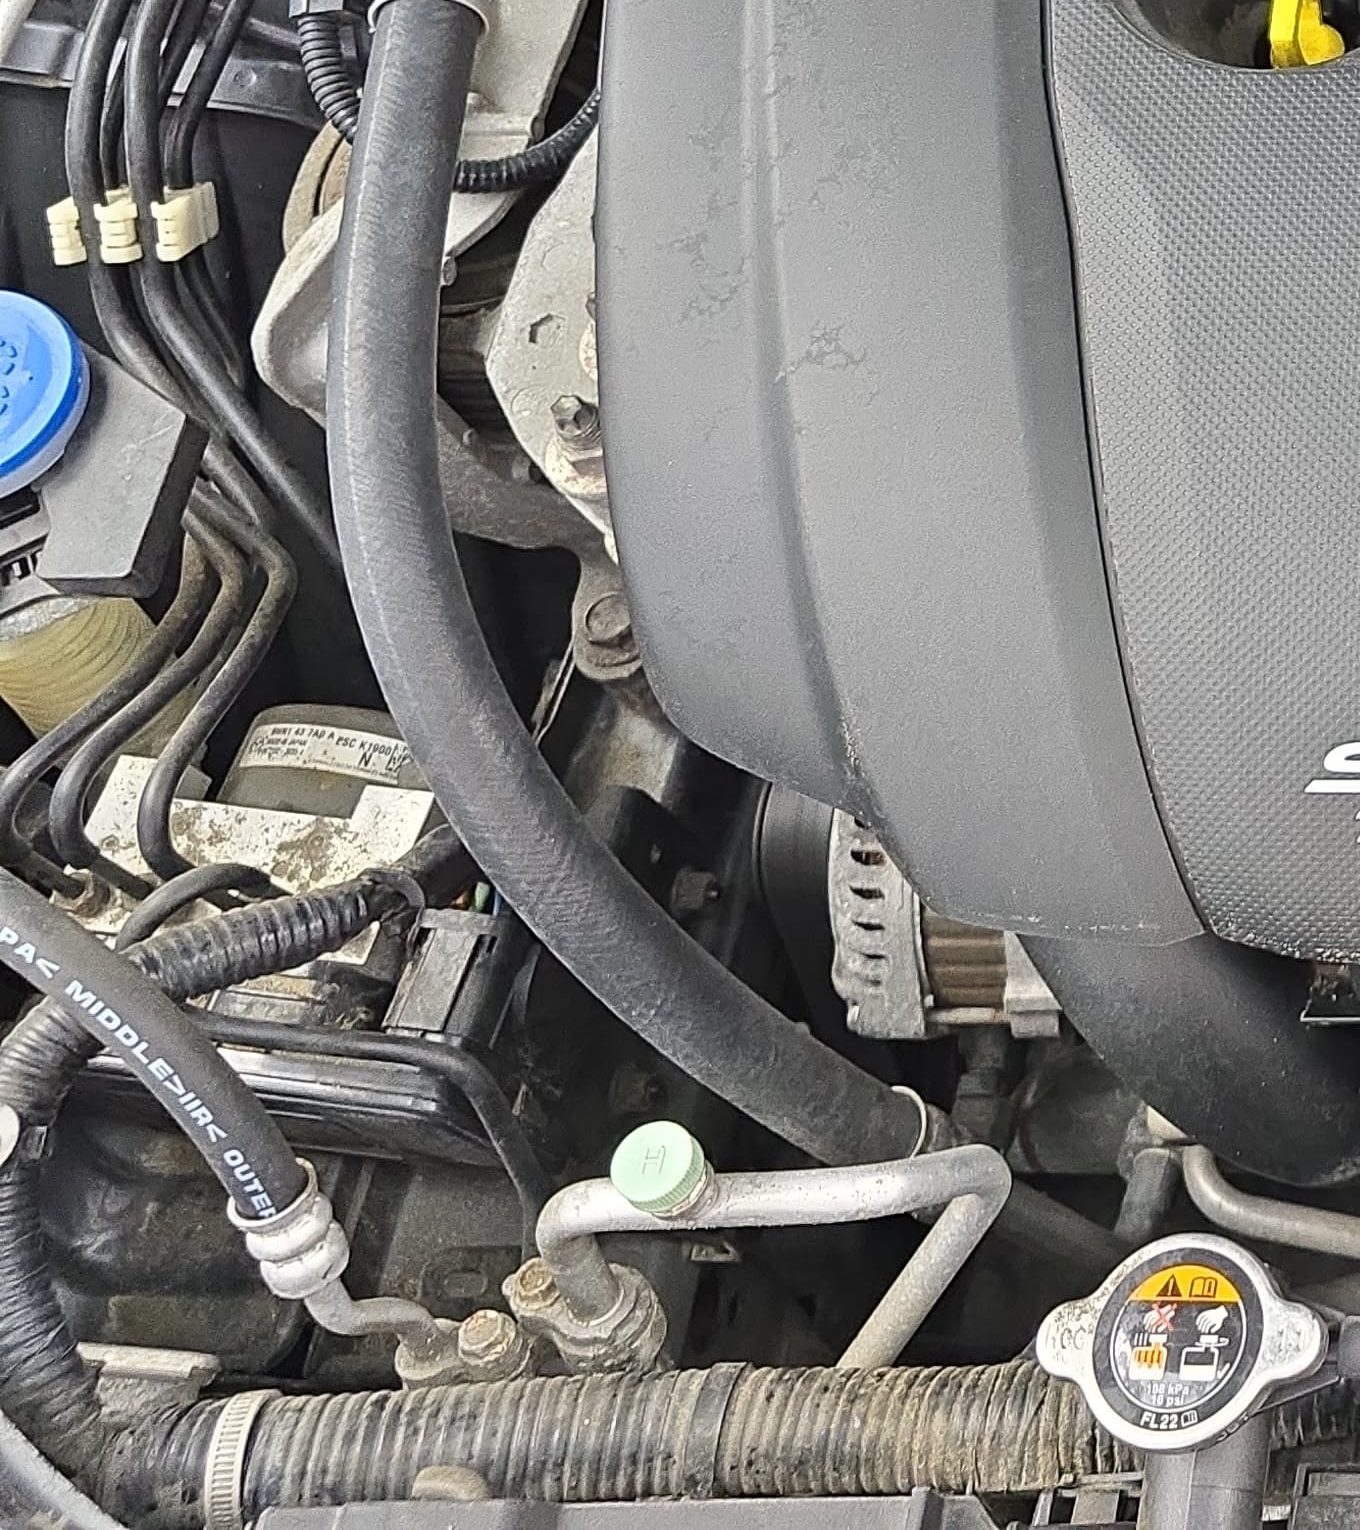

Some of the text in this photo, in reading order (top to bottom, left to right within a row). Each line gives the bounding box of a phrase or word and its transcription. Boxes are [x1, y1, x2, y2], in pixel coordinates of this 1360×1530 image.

[1168, 1382, 1190, 1397] kPa
[1166, 1395, 1185, 1409] psi
[1140, 1412, 1179, 1431] FL22
